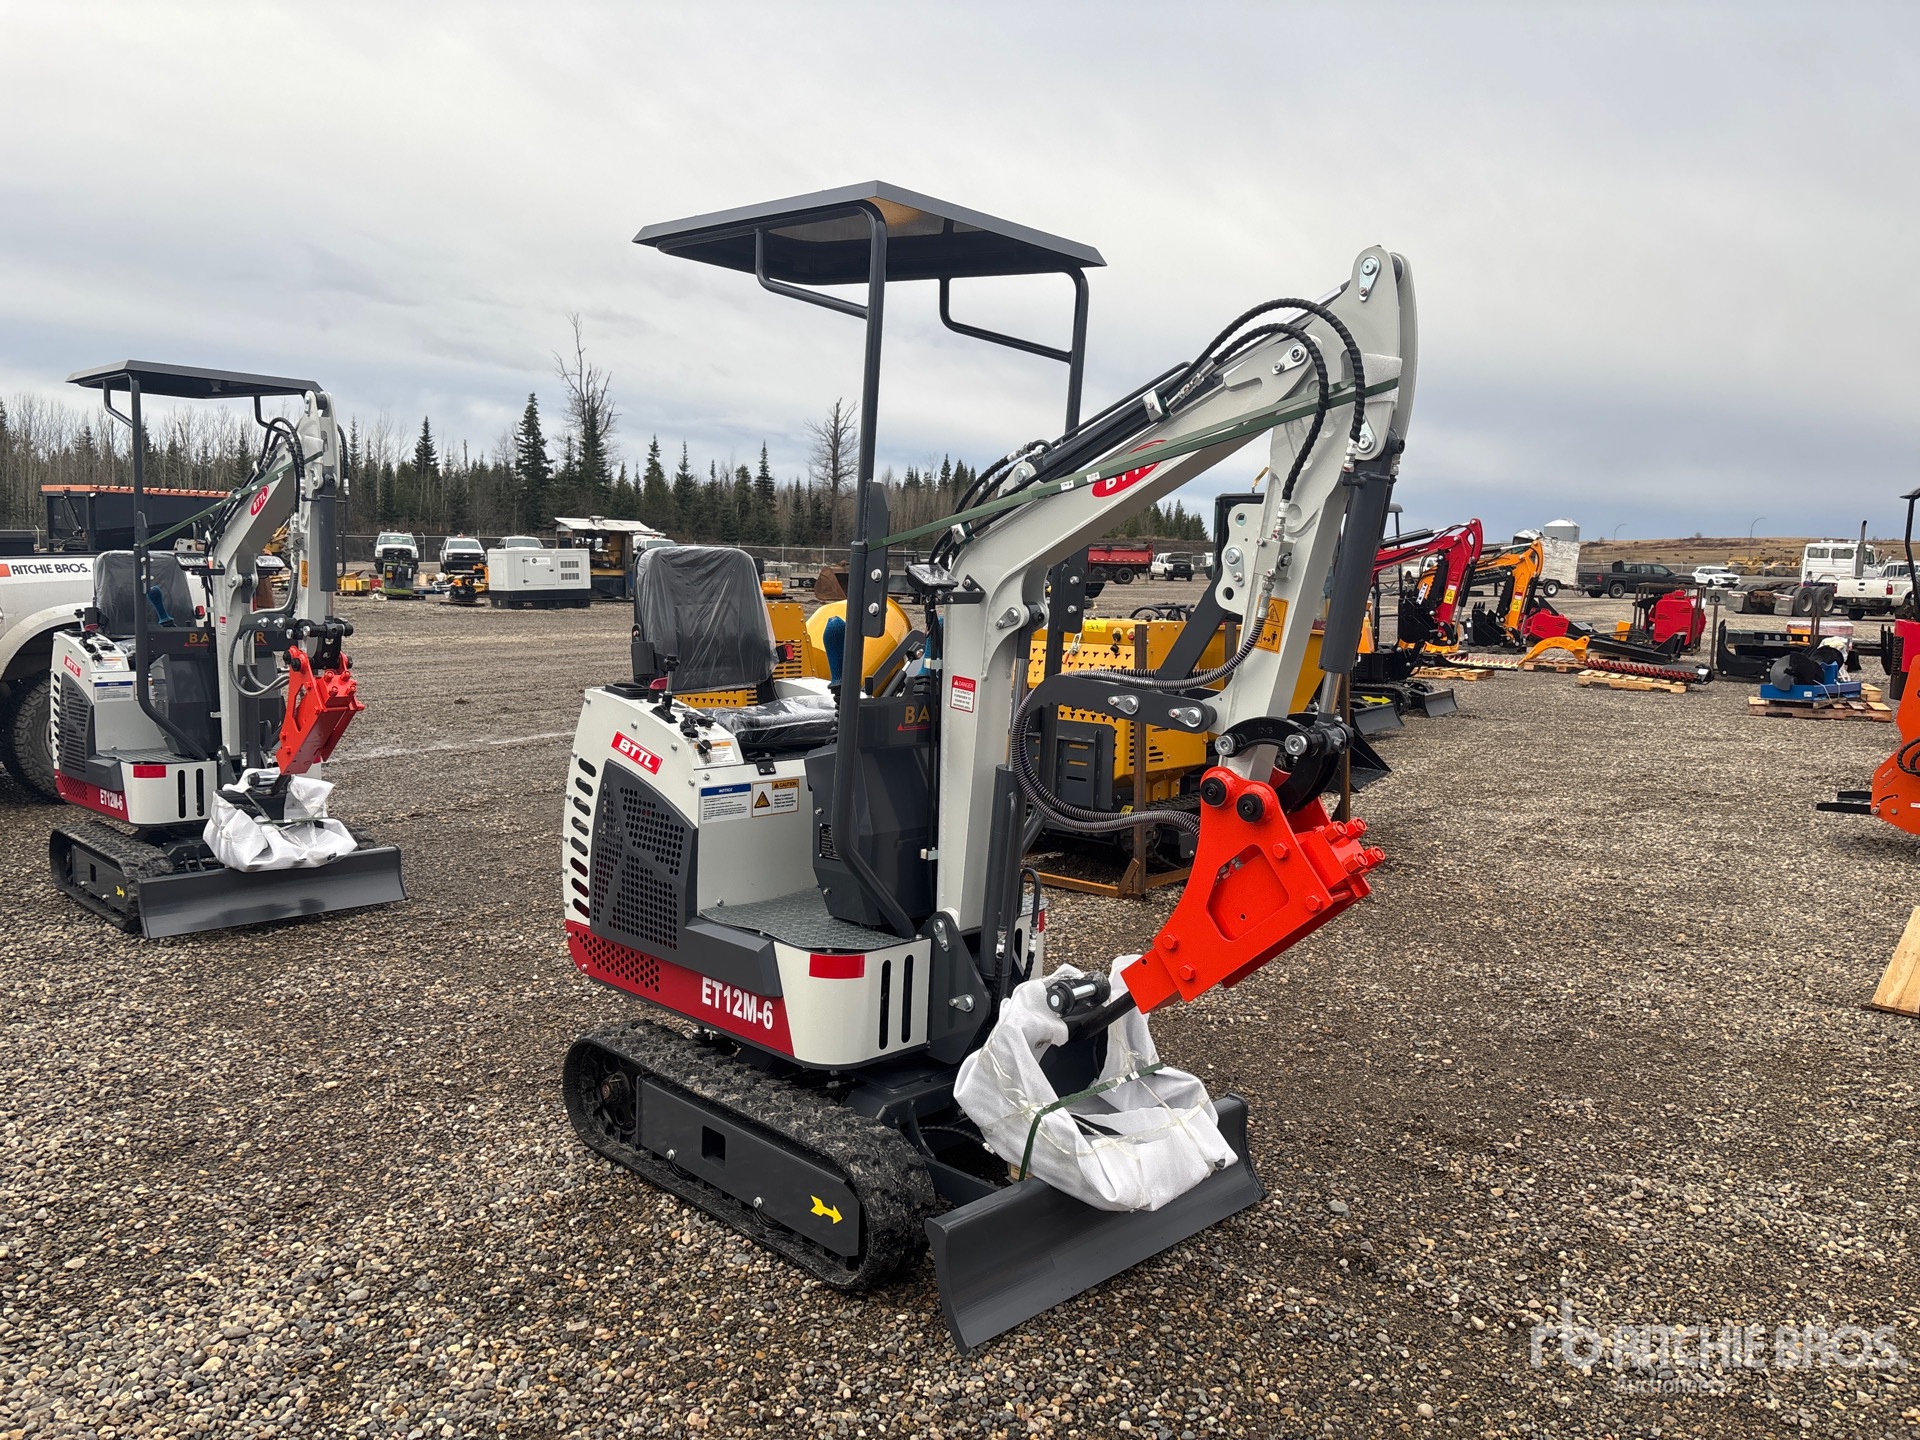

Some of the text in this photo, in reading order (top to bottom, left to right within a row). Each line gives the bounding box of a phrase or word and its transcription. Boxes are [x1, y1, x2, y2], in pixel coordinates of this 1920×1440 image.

[253, 491, 266, 511] BTTL
[11, 563, 91, 575] RITCHIE BROS.
[66, 659, 79, 675] BTTL
[958, 680, 974, 690] DANGER
[618, 738, 653, 769] BTTL
[779, 780, 797, 788] CAUTION
[100, 788, 124, 811] ET12M-6
[701, 976, 774, 1030] ET12M-6
